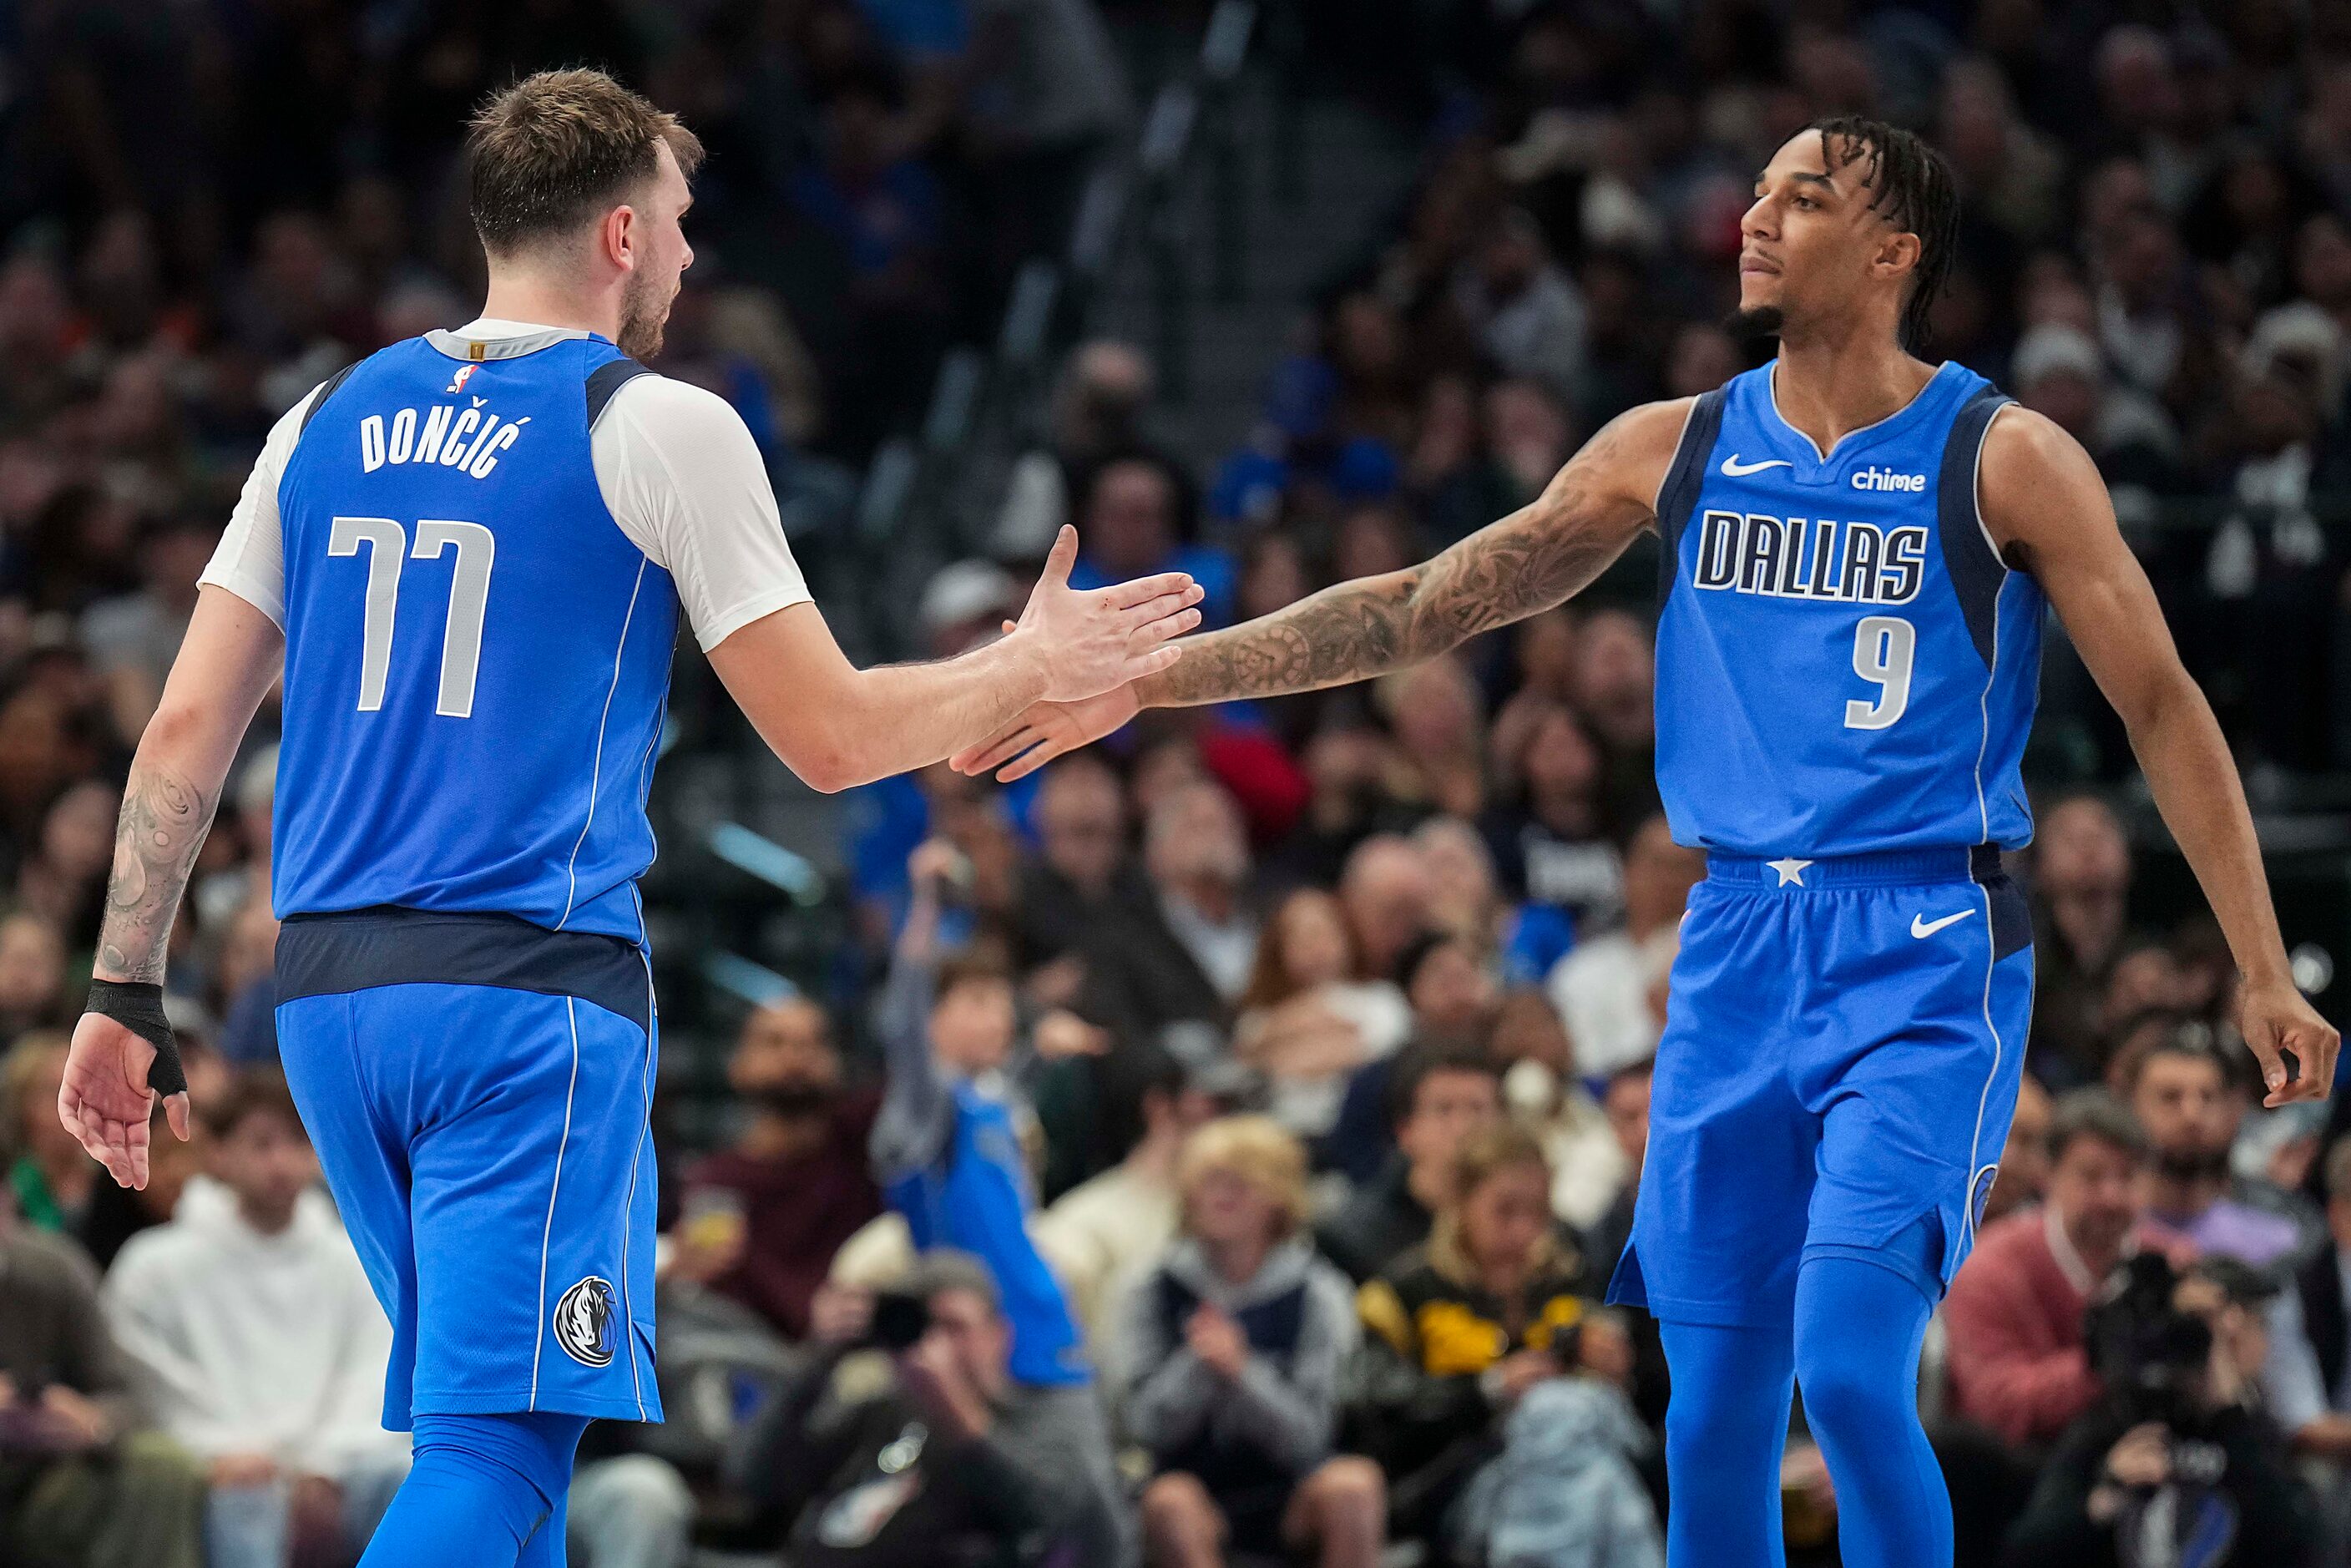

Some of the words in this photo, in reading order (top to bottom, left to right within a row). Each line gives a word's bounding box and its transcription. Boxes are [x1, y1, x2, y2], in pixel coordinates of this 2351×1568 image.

[360, 395, 531, 479] DONČIĆ
[1851, 466, 1925, 493] chime
[1693, 509, 1929, 605] DALLAS
[327, 516, 495, 718] 77
[1843, 616, 1916, 730] 9
